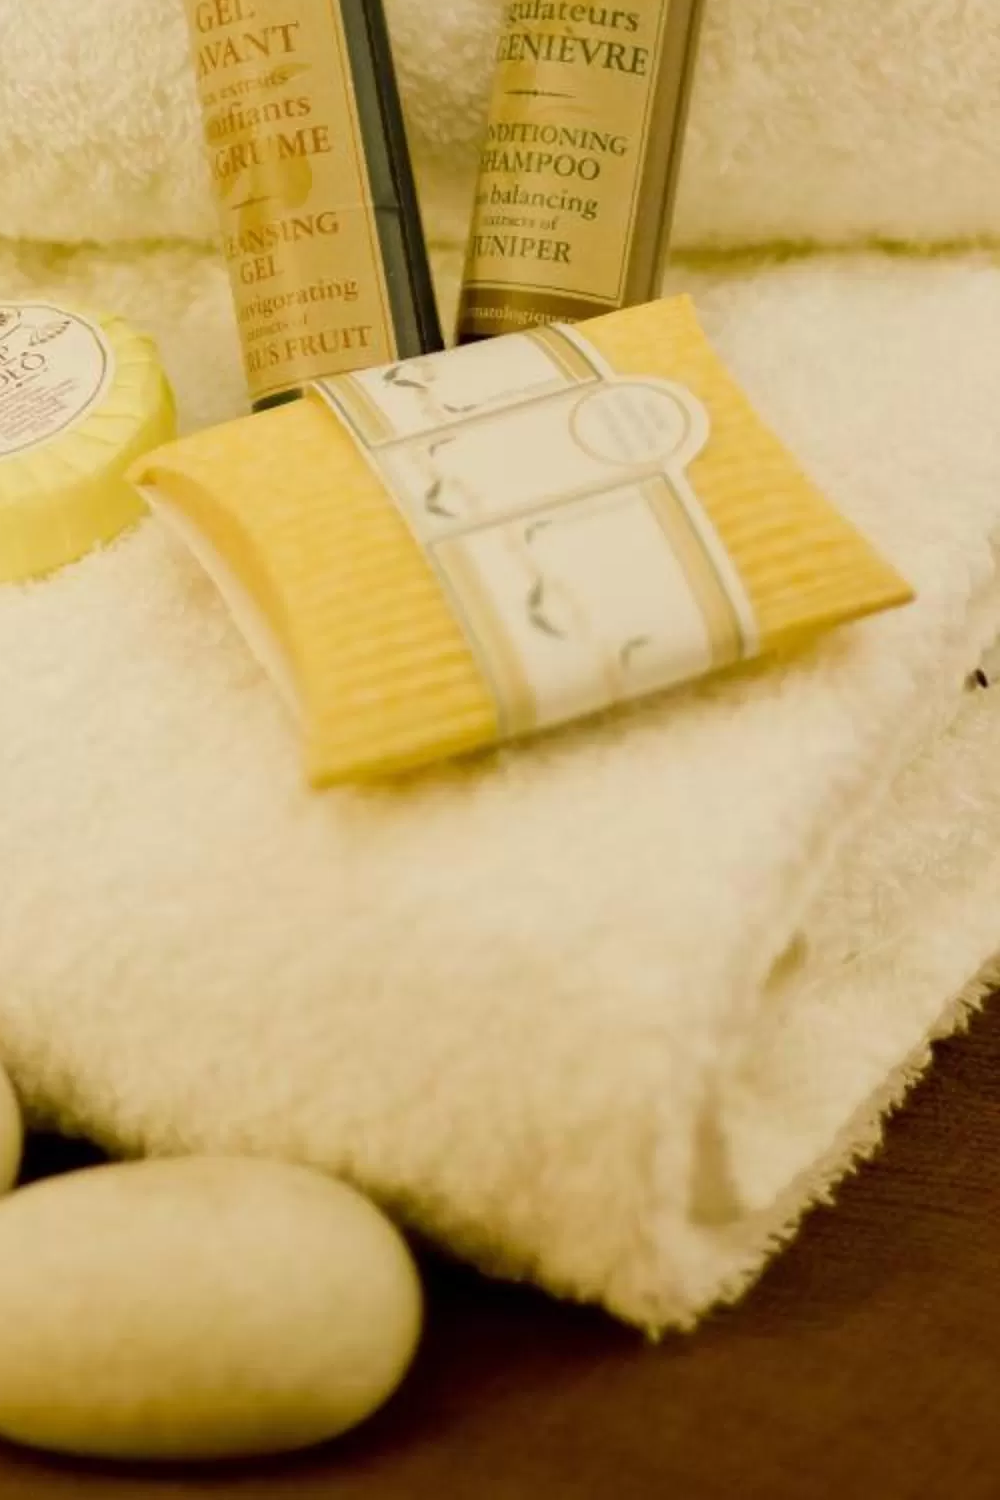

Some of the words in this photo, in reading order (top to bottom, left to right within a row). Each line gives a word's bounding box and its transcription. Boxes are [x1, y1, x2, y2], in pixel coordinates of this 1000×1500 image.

[490, 183, 600, 221] balancing
[239, 254, 284, 286] GEL
[284, 324, 373, 361] FRUIT
